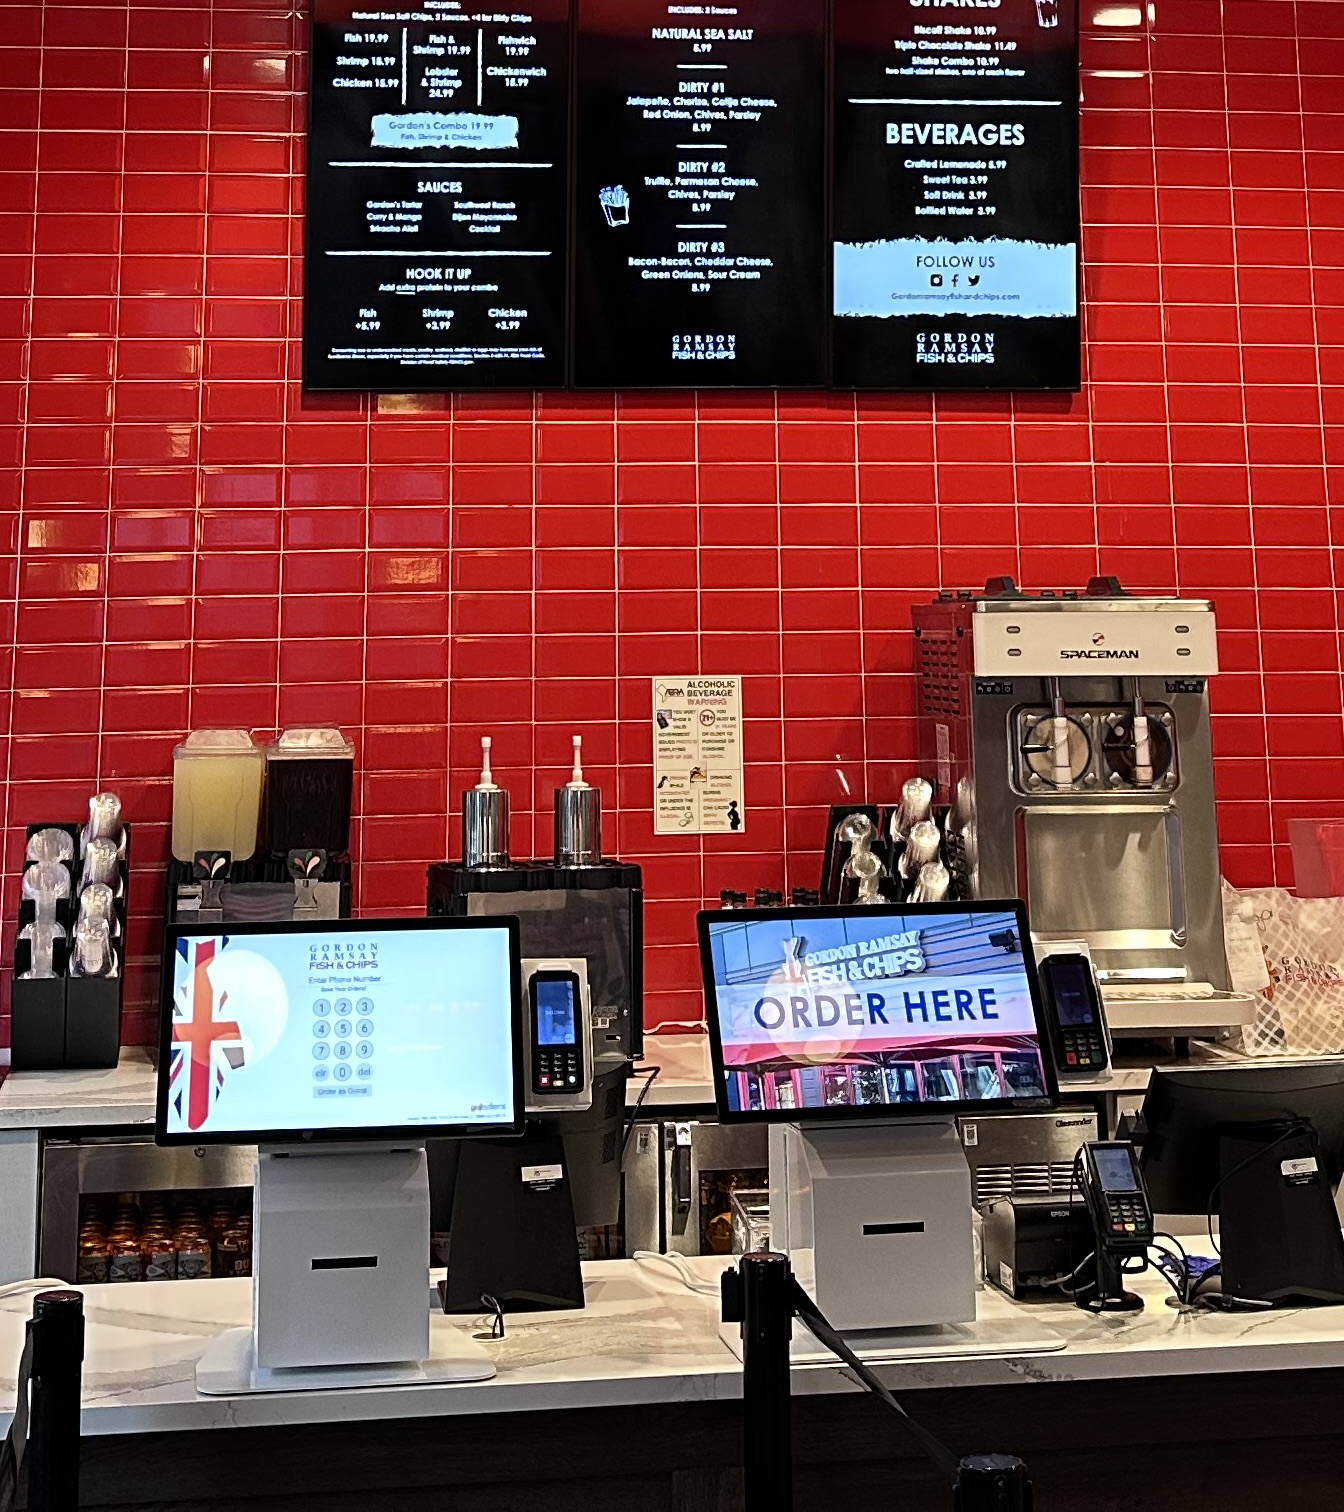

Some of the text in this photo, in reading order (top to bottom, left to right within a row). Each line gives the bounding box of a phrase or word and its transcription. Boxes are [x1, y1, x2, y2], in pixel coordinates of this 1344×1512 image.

[345, 33, 388, 43] Fish 19.99
[429, 35, 446, 43] Fish
[652, 28, 753, 40] NATURAL SEA SALT
[498, 36, 536, 45] Fishwich
[413, 45, 471, 56] Shrimp 19.99
[506, 47, 529, 55] 19.99
[336, 56, 369, 67] Shrimp
[425, 67, 458, 76] Lobster
[486, 67, 546, 76] Chickenwich
[333, 78, 372, 87] Chicken
[430, 78, 462, 90] Shrimp
[679, 82, 724, 93] DIRTY #1
[429, 89, 453, 97] 24.99
[643, 110, 661, 118] Red
[887, 123, 1024, 145] BEVERAGES
[679, 162, 725, 172] DIRTY #2
[952, 175, 968, 184] Tea
[418, 182, 462, 193] SAUCES
[942, 191, 964, 199] Drink
[678, 242, 725, 252] DIRTY #3
[917, 256, 995, 268] FOLLOW US
[406, 268, 471, 279] HOOK IT UP
[642, 270, 670, 279] Green
[708, 270, 727, 279] Sour
[729, 270, 760, 279] Cream
[360, 309, 376, 317] Fish
[422, 309, 454, 319] Shrimp
[488, 308, 527, 317] Chicken
[673, 335, 735, 343] GORDON
[917, 333, 994, 343] GORDON
[673, 343, 735, 351] RAMSAY
[917, 343, 994, 352] RAMSAY
[672, 350, 695, 359] FISH
[706, 350, 735, 359] CHIPS
[917, 353, 994, 363] FISH & CHIPS
[1061, 650, 1138, 658] SPACEMAN
[309, 942, 379, 954] GORDON
[805, 930, 921, 967] GORDON RAMSAY
[309, 951, 379, 961] RAMSAY
[308, 960, 379, 971] FISH & CHIPS
[806, 948, 925, 989] FISH & CHIPS
[318, 1003, 325, 1013] 1
[340, 1002, 347, 1013] 2
[361, 1001, 369, 1012] 3
[754, 987, 1000, 1031] ORDER HERE
[318, 1024, 325, 1035] 4
[340, 1023, 347, 1034] 5
[361, 1023, 368, 1033] 6
[318, 1046, 325, 1056] 7
[339, 1045, 346, 1056] 8
[361, 1044, 368, 1055] 9
[339, 1067, 346, 1078] 0
[358, 1067, 371, 1076] del
